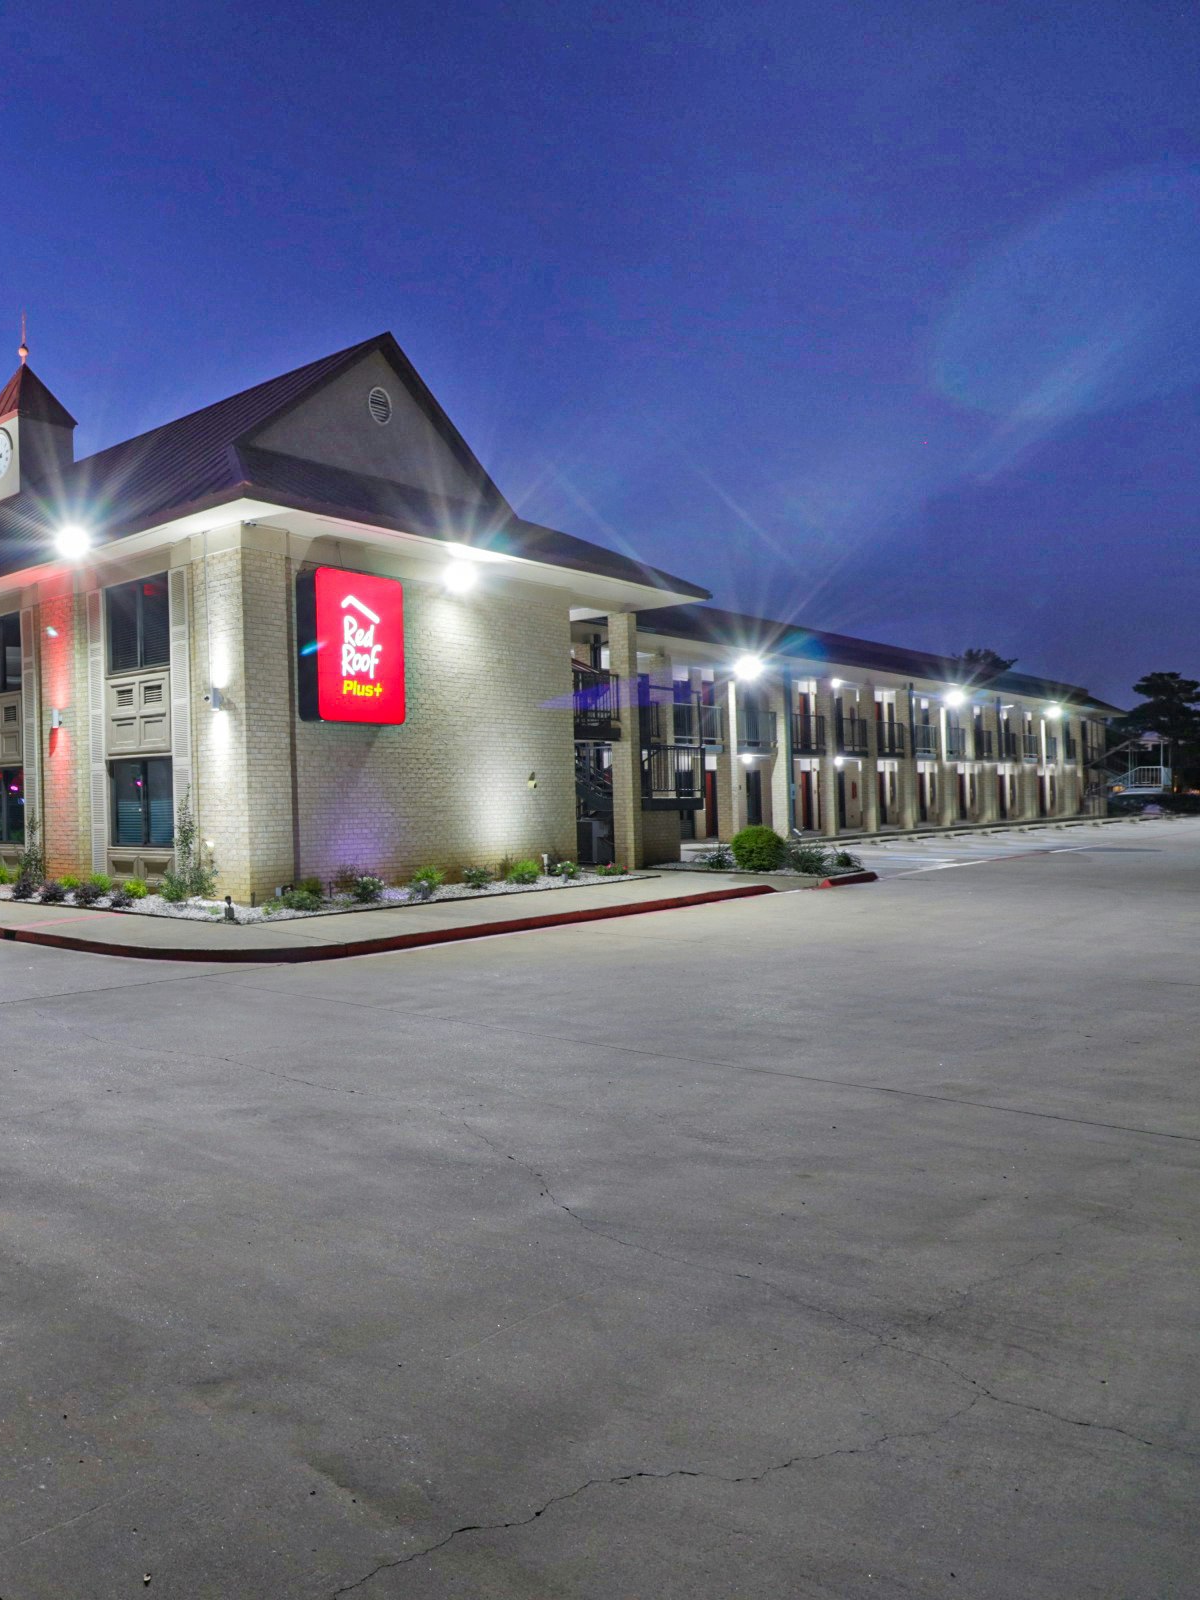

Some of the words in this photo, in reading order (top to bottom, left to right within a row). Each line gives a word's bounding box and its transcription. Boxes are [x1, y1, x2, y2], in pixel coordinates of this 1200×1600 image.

[343, 615, 375, 648] Red
[341, 643, 383, 679] Roof
[342, 679, 383, 697] Plus+
